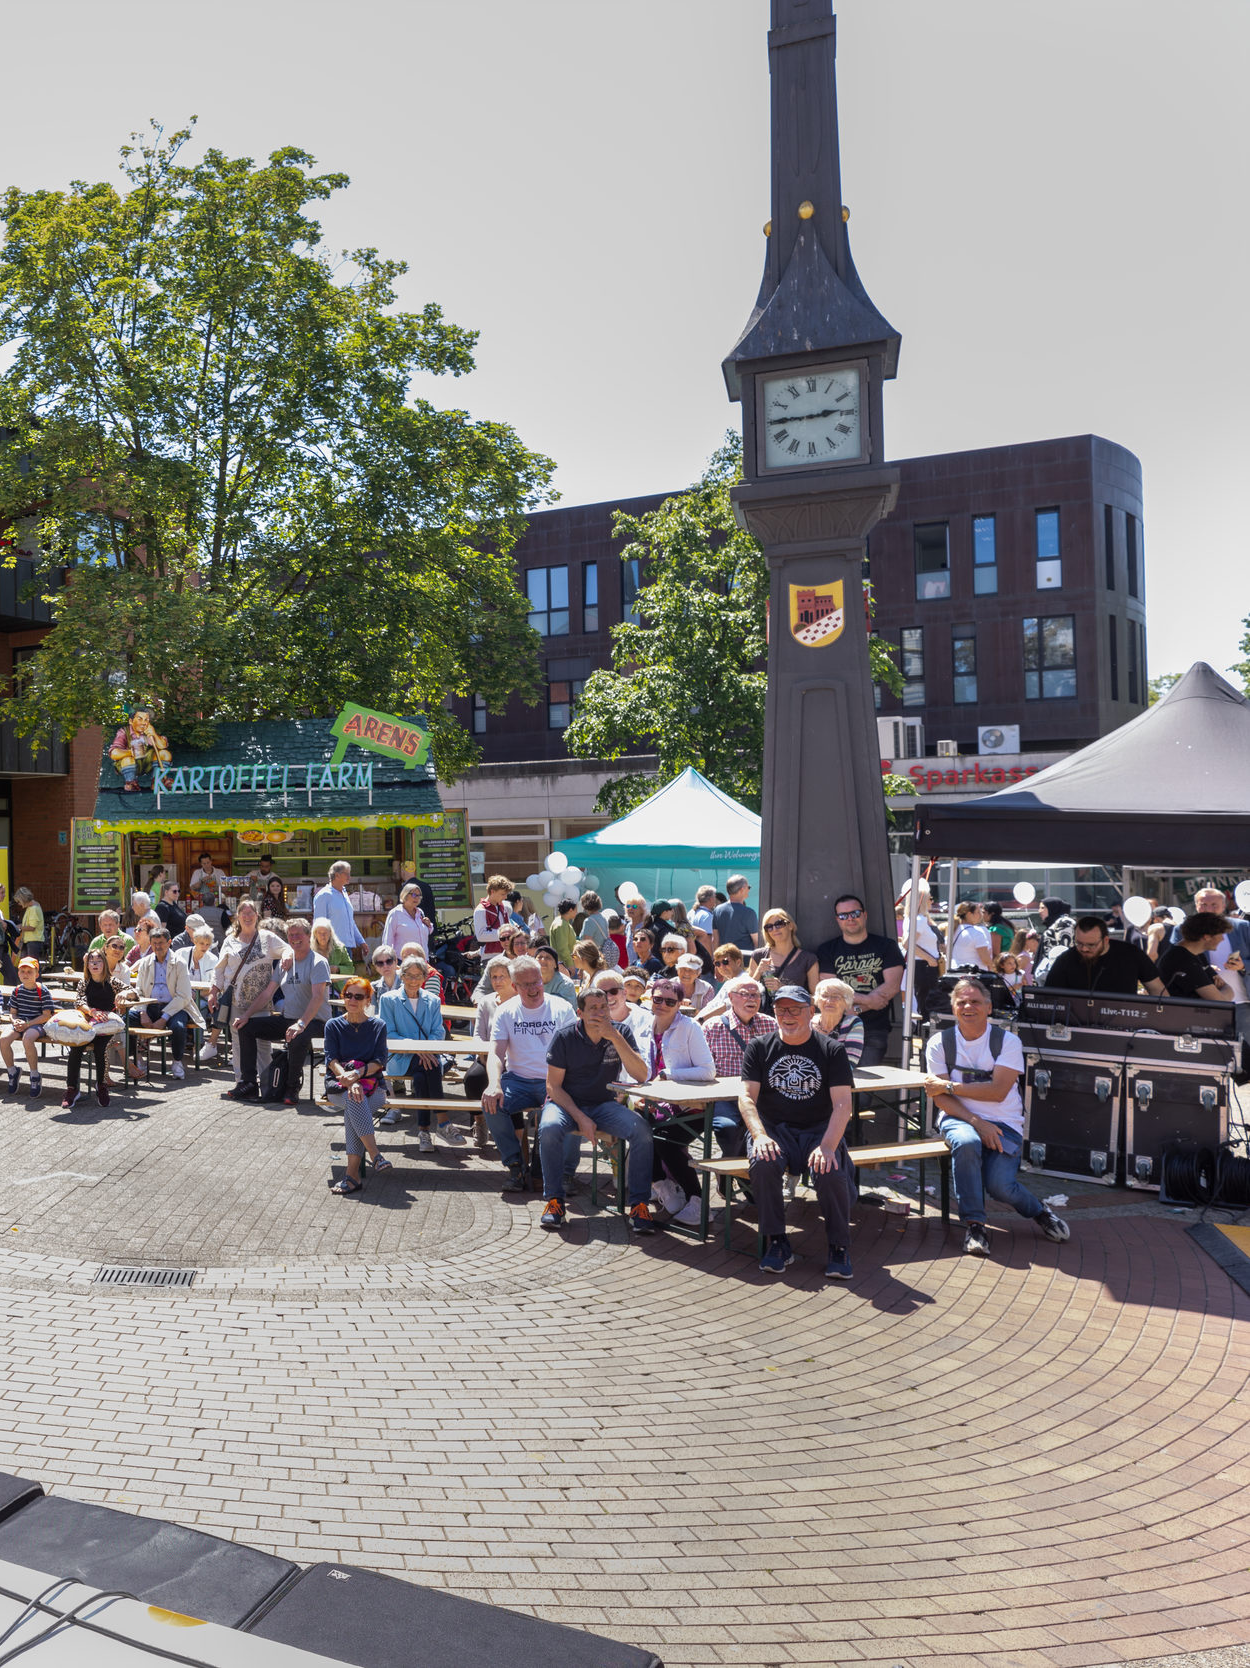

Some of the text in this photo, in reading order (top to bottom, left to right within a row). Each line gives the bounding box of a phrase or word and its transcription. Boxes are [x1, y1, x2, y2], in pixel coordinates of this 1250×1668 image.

[343, 713, 422, 757] ARENS
[153, 761, 374, 795] KARTOFFEL FARM
[909, 762, 1049, 791] Sparkass
[835, 955, 884, 975] Garage
[513, 1020, 557, 1028] MORGAN
[513, 1027, 556, 1036] FINLAY
